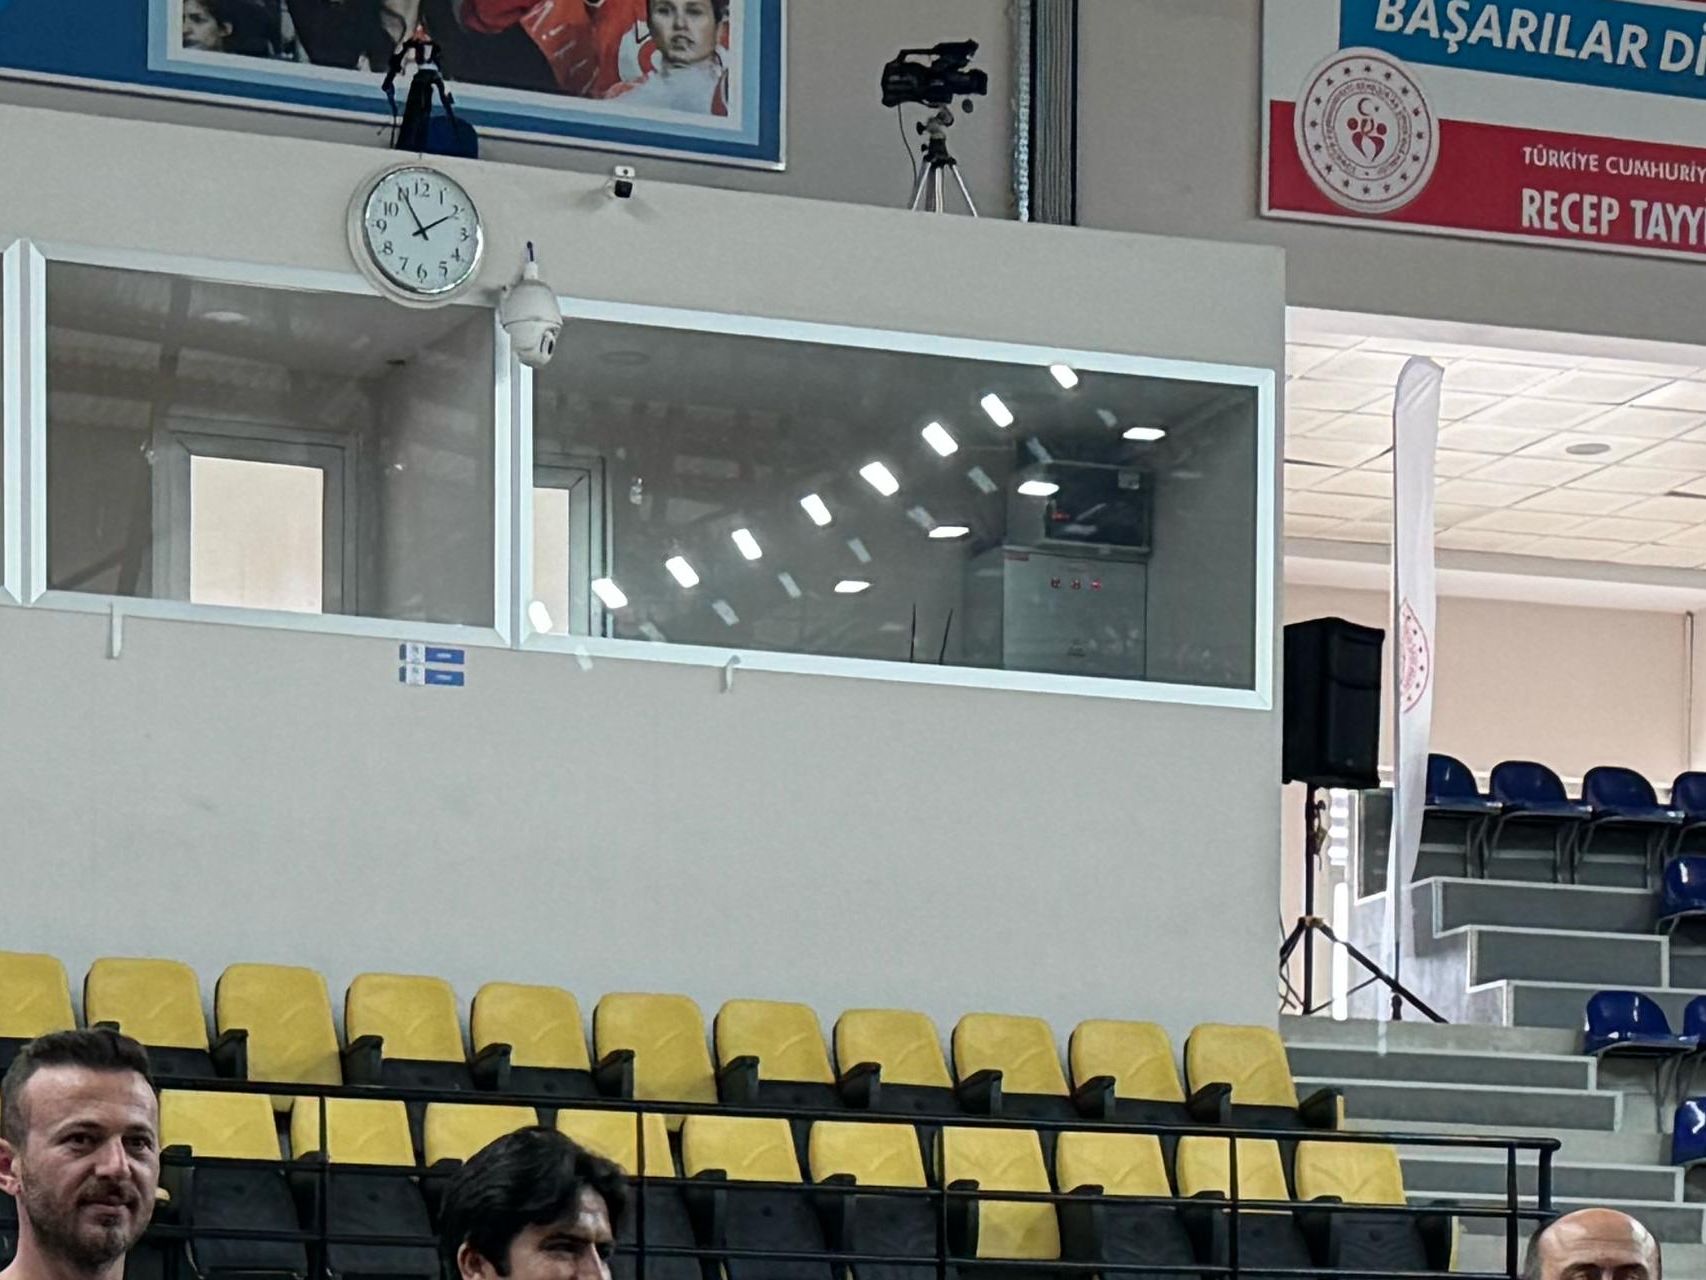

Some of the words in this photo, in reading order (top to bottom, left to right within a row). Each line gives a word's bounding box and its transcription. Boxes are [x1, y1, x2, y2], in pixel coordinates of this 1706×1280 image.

[1374, 0, 1648, 69] BAŞARILAR
[1522, 145, 1599, 173] TÜRKİYE
[414, 180, 430, 198] 12
[1520, 187, 1621, 237] RECEP
